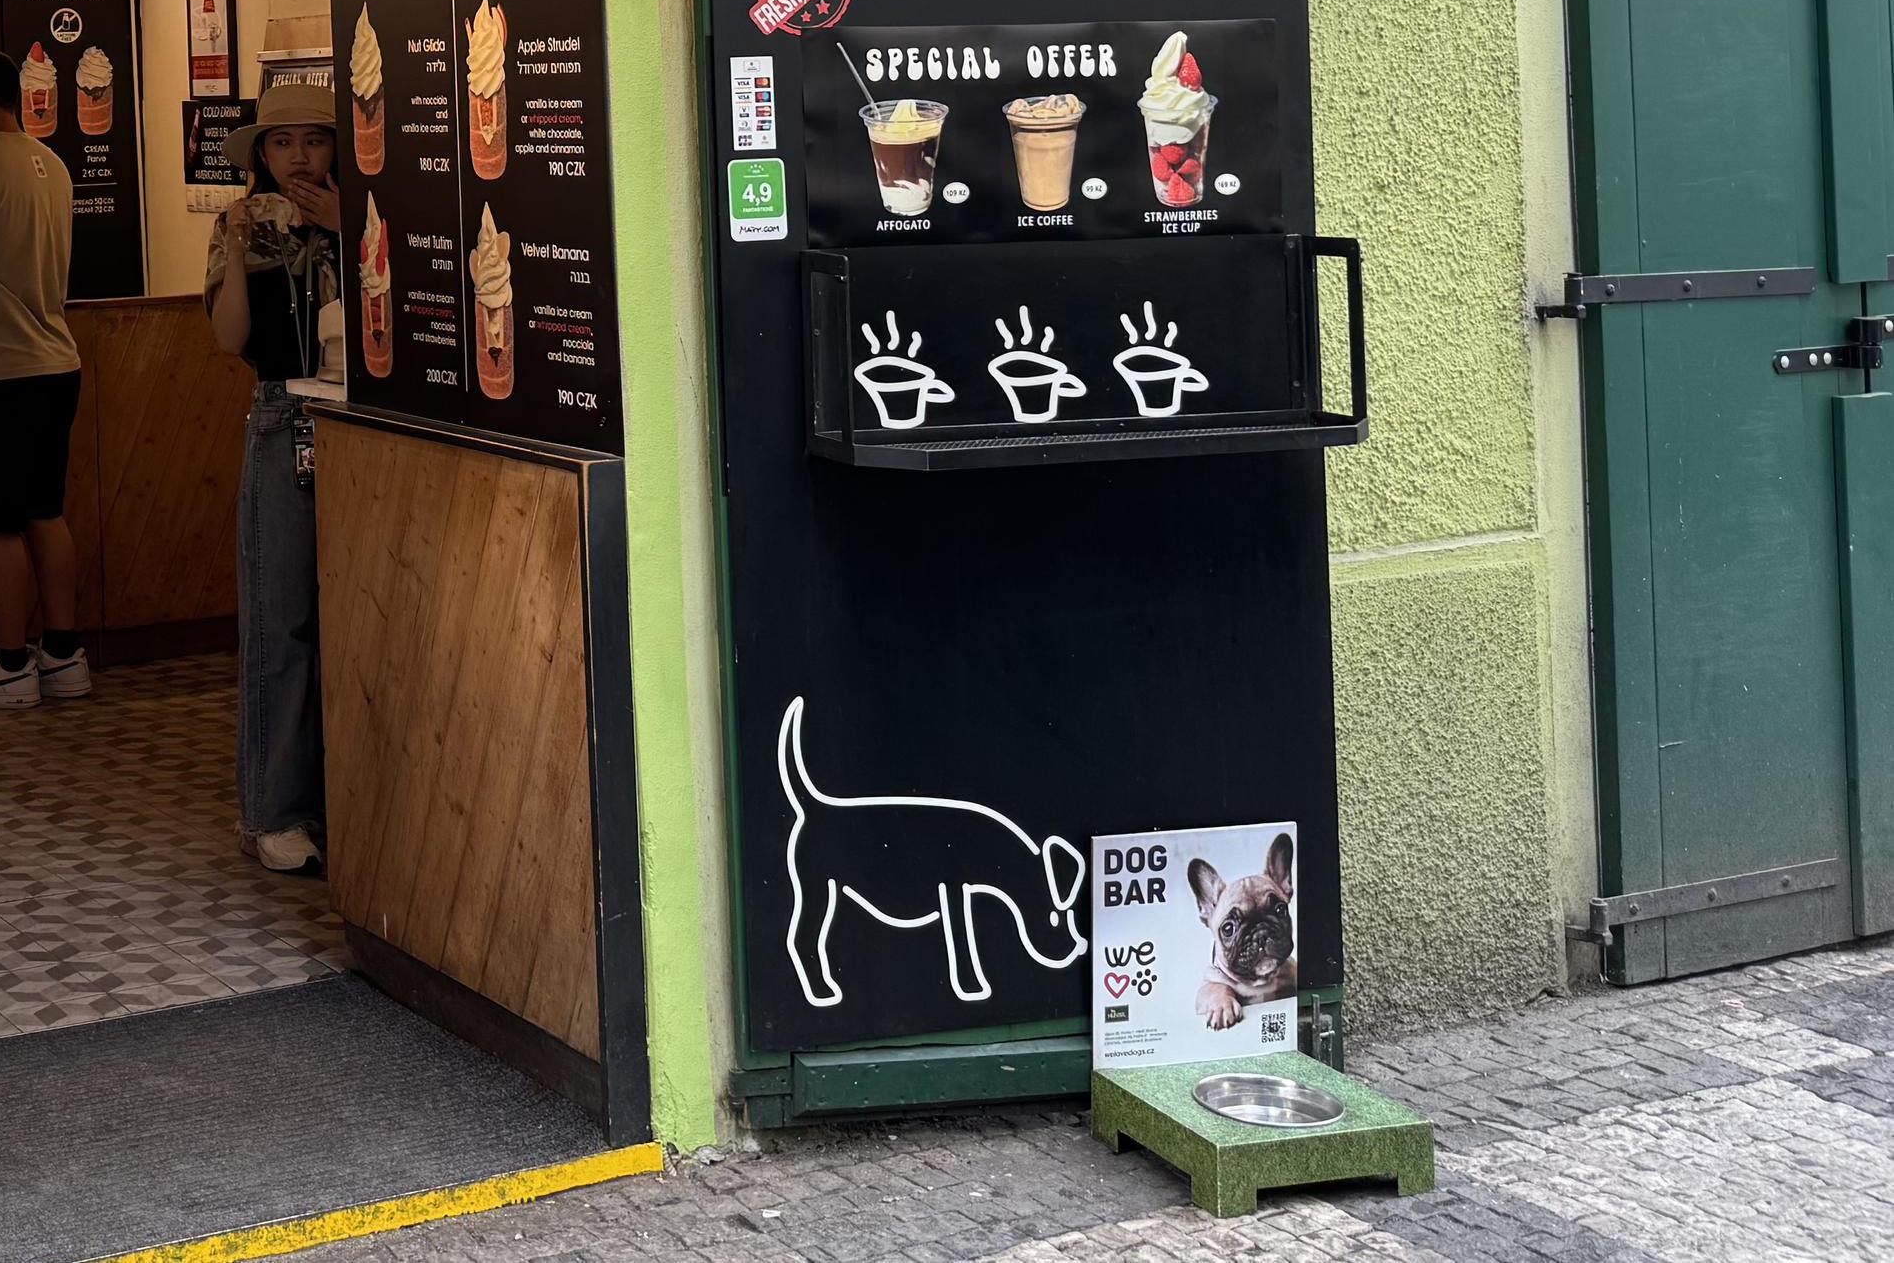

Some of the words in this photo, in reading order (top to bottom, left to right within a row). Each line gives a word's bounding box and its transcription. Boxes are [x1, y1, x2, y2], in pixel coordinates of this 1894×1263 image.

[408, 39, 422, 53] Nut
[423, 38, 446, 52] Glida
[517, 38, 546, 56] Apple
[547, 37, 581, 52] Strudel
[865, 45, 1001, 82] SPECIAL
[1026, 44, 1118, 79] OFFER
[272, 72, 301, 88] SPECIAL
[306, 72, 329, 88] OFFER
[203, 106, 219, 117] COLD
[220, 105, 241, 117] DRINKS
[526, 98, 547, 109] vanilla
[548, 98, 558, 108] ice
[560, 99, 582, 109] cream
[436, 109, 448, 119] and
[401, 123, 419, 134] vanilla
[420, 123, 428, 133] ice
[430, 124, 448, 133] cream
[529, 128, 546, 139] white
[547, 128, 584, 139] chocolate,
[84, 145, 109, 153] CREAM
[515, 144, 534, 155] apple
[536, 143, 549, 154] and
[550, 143, 584, 154] cinnamon
[419, 157, 432, 172] 180
[434, 157, 450, 172] CZK
[549, 161, 563, 176] 190
[566, 161, 585, 177] CZK
[742, 183, 772, 206] 4,9
[1018, 216, 1035, 227] ICE
[1037, 215, 1074, 226] COFFEE
[1144, 210, 1218, 222] STRAWBERRIES
[876, 218, 931, 232] AFFOGATO
[1162, 223, 1178, 233] ICE
[1180, 222, 1200, 233] CUP
[407, 232, 431, 249] Velvet
[432, 234, 453, 250] Tutim
[521, 242, 549, 259] Velvet
[552, 244, 589, 261] Banana
[570, 270, 590, 284] בננה
[408, 291, 426, 303] vanilla
[427, 293, 435, 302] ice
[436, 294, 455, 304] cream
[533, 305, 555, 317] vanilla
[557, 306, 567, 318] ice
[569, 308, 592, 320] cream
[562, 338, 594, 350] nocciola
[547, 351, 561, 362] and
[563, 352, 595, 366] bananas
[426, 368, 441, 383] 200
[442, 370, 457, 385] CZK
[558, 389, 573, 406] 190
[577, 391, 597, 409] CZK
[1104, 845, 1167, 875] DOG
[1104, 878, 1166, 907] BAR
[1105, 941, 1156, 968] we
[1105, 1049, 1155, 1057] welovedogs.cz
